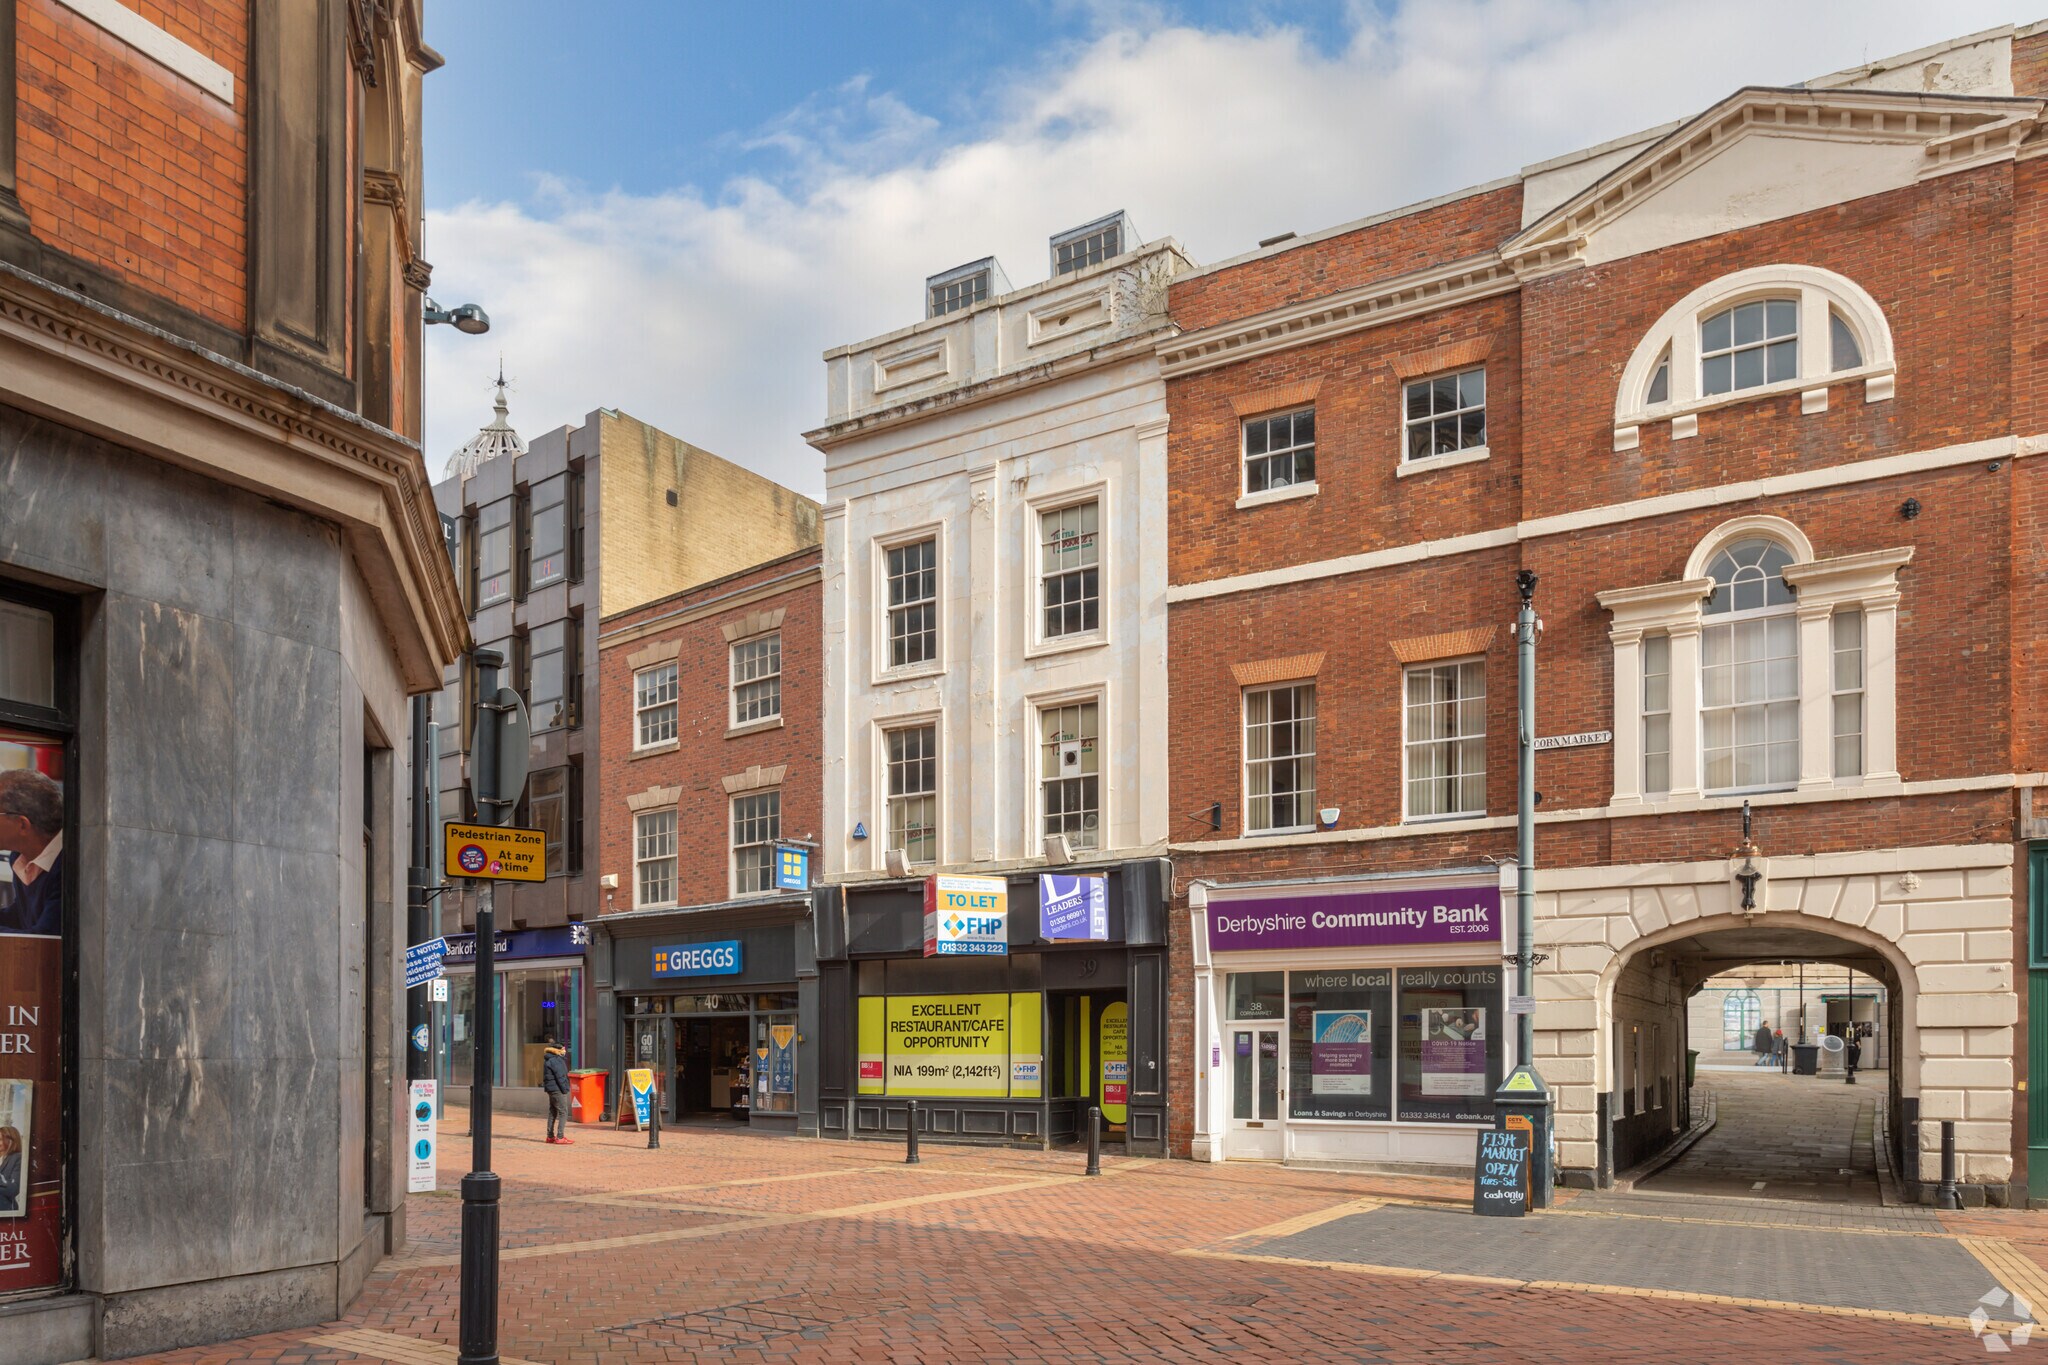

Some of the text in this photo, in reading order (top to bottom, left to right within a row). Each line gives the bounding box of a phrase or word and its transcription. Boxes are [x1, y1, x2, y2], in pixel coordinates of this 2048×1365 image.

[1533, 732, 1609, 748] CORNMARKET
[451, 828, 541, 844] Pedestrian Zone
[498, 850, 534, 863] At any
[505, 862, 528, 872] time
[946, 893, 997, 908] TO LET
[1046, 895, 1083, 916] LEADERS
[1094, 884, 1105, 936] TO LET
[967, 917, 1002, 935] FHP
[1217, 904, 1489, 935] Derbyshire Community Bank
[1449, 924, 1489, 934] EST. 2006
[416, 941, 443, 956] NOTICE
[446, 942, 464, 955] Bank
[464, 941, 474, 954] of
[941, 943, 1004, 953] 01332 343 222
[670, 947, 734, 970] GREGGS
[1078, 960, 1097, 977] 39
[1305, 970, 1497, 988] where local really counts
[704, 994, 719, 1009] 40
[1250, 1002, 1262, 1010] 38
[8, 1005, 40, 1026] IN
[911, 1003, 981, 1016] EXCELLENT
[890, 1019, 1005, 1033] RESTAURANT/CAFE
[641, 1034, 652, 1046] GO
[903, 1035, 990, 1049] OPPORTUNITY
[894, 1065, 913, 1076] NIA
[1321, 1110, 1346, 1118] Savings
[1355, 1111, 1387, 1119] Derbyshire
[1455, 1113, 1495, 1121] dcbank.org
[1482, 1132, 1517, 1147] FISH
[1481, 1146, 1528, 1162] MARKET
[1485, 1162, 1519, 1178] OPEN
[1480, 1175, 1518, 1187] Tues-Sat
[1504, 1190, 1524, 1204] only
